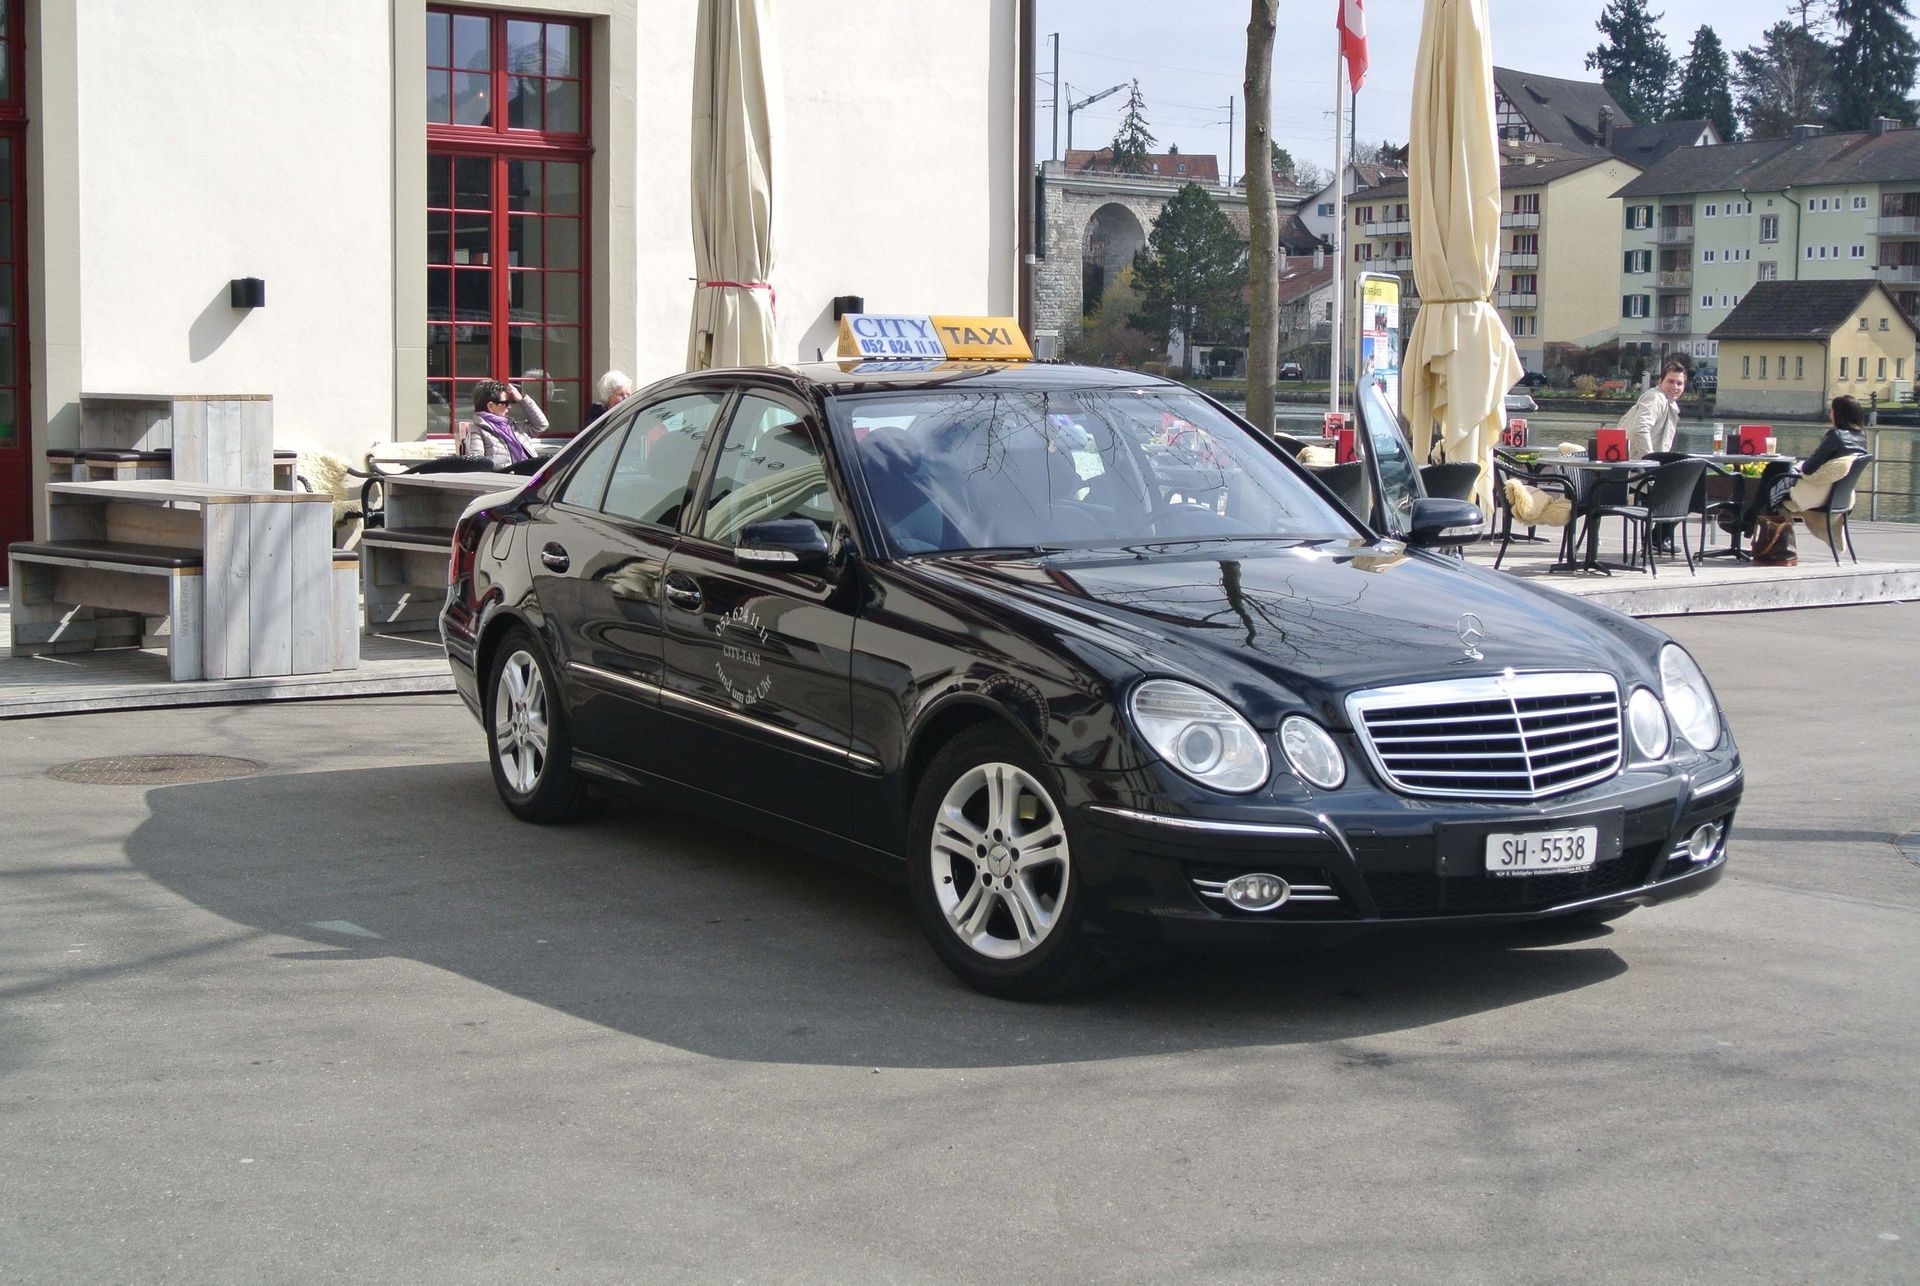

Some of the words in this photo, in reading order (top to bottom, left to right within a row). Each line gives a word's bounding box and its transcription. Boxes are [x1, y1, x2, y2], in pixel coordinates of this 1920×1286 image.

[853, 318, 927, 339] CITY
[942, 327, 1013, 345] TAXI
[861, 339, 886, 354] 052
[891, 340, 913, 354] 624
[716, 612, 730, 637] 052
[732, 607, 748, 623] 624
[723, 645, 761, 666] CITY-TAXI
[732, 690, 744, 704] um
[745, 689, 757, 704] die
[757, 675, 771, 699] Uhr
